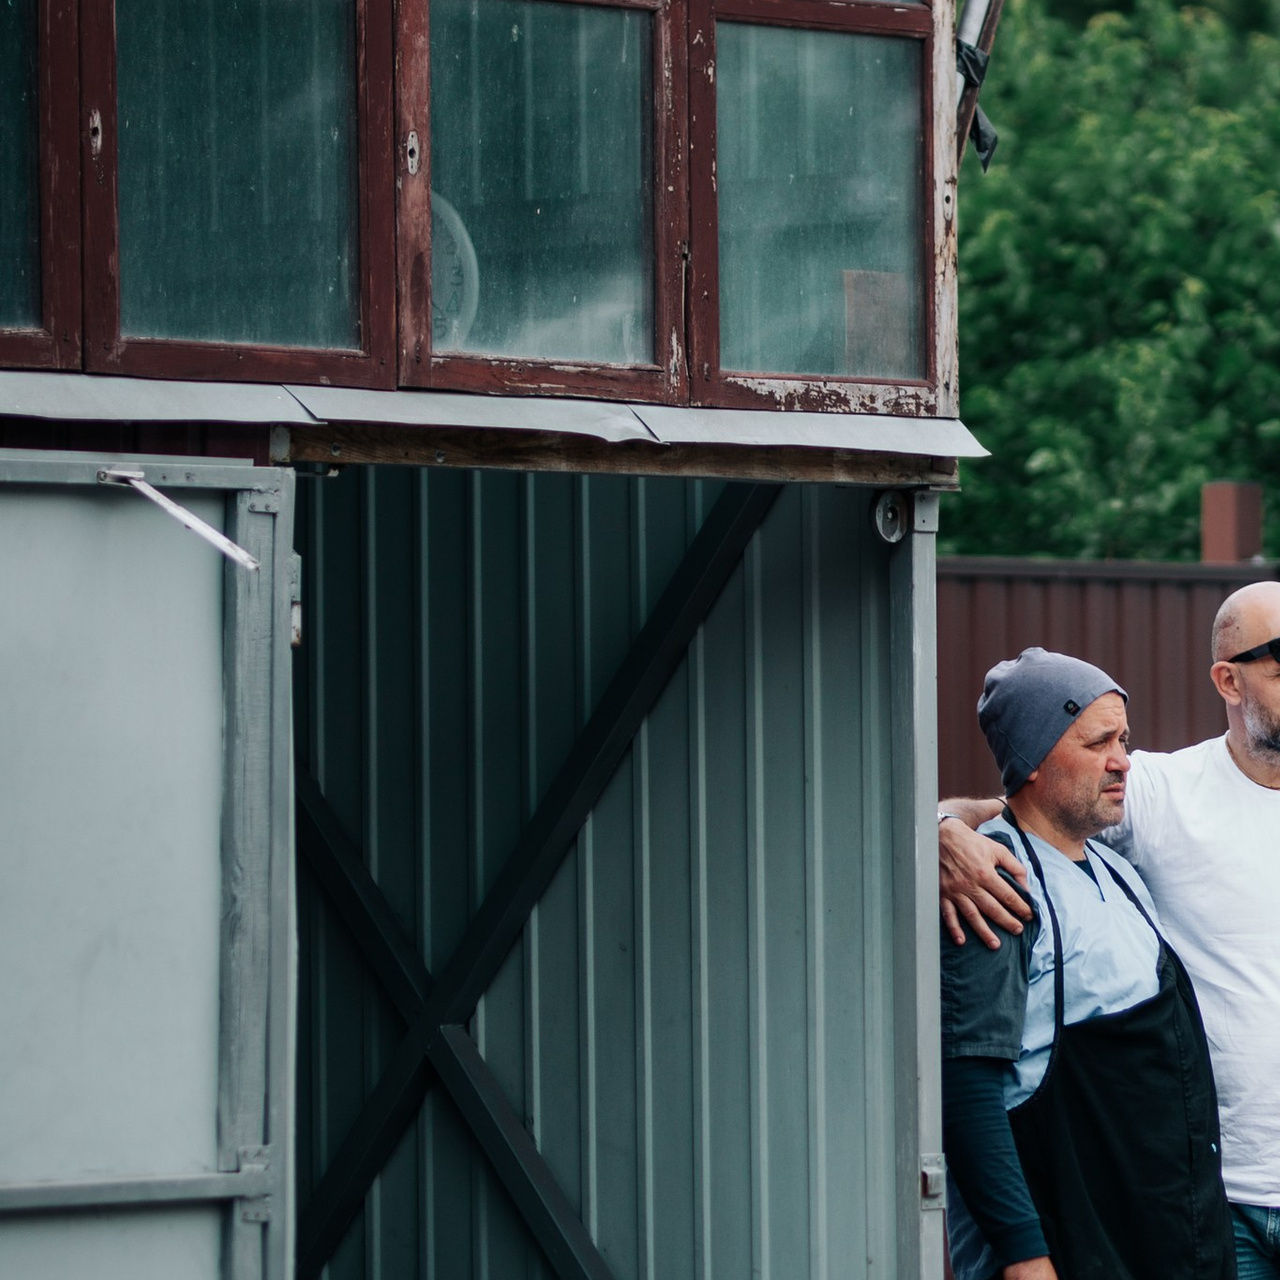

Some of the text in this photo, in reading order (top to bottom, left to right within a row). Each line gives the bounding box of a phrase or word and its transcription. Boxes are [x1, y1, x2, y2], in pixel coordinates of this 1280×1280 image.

[451, 266, 463, 286] 3
[445, 290, 459, 314] 4
[434, 317, 447, 339] 5
